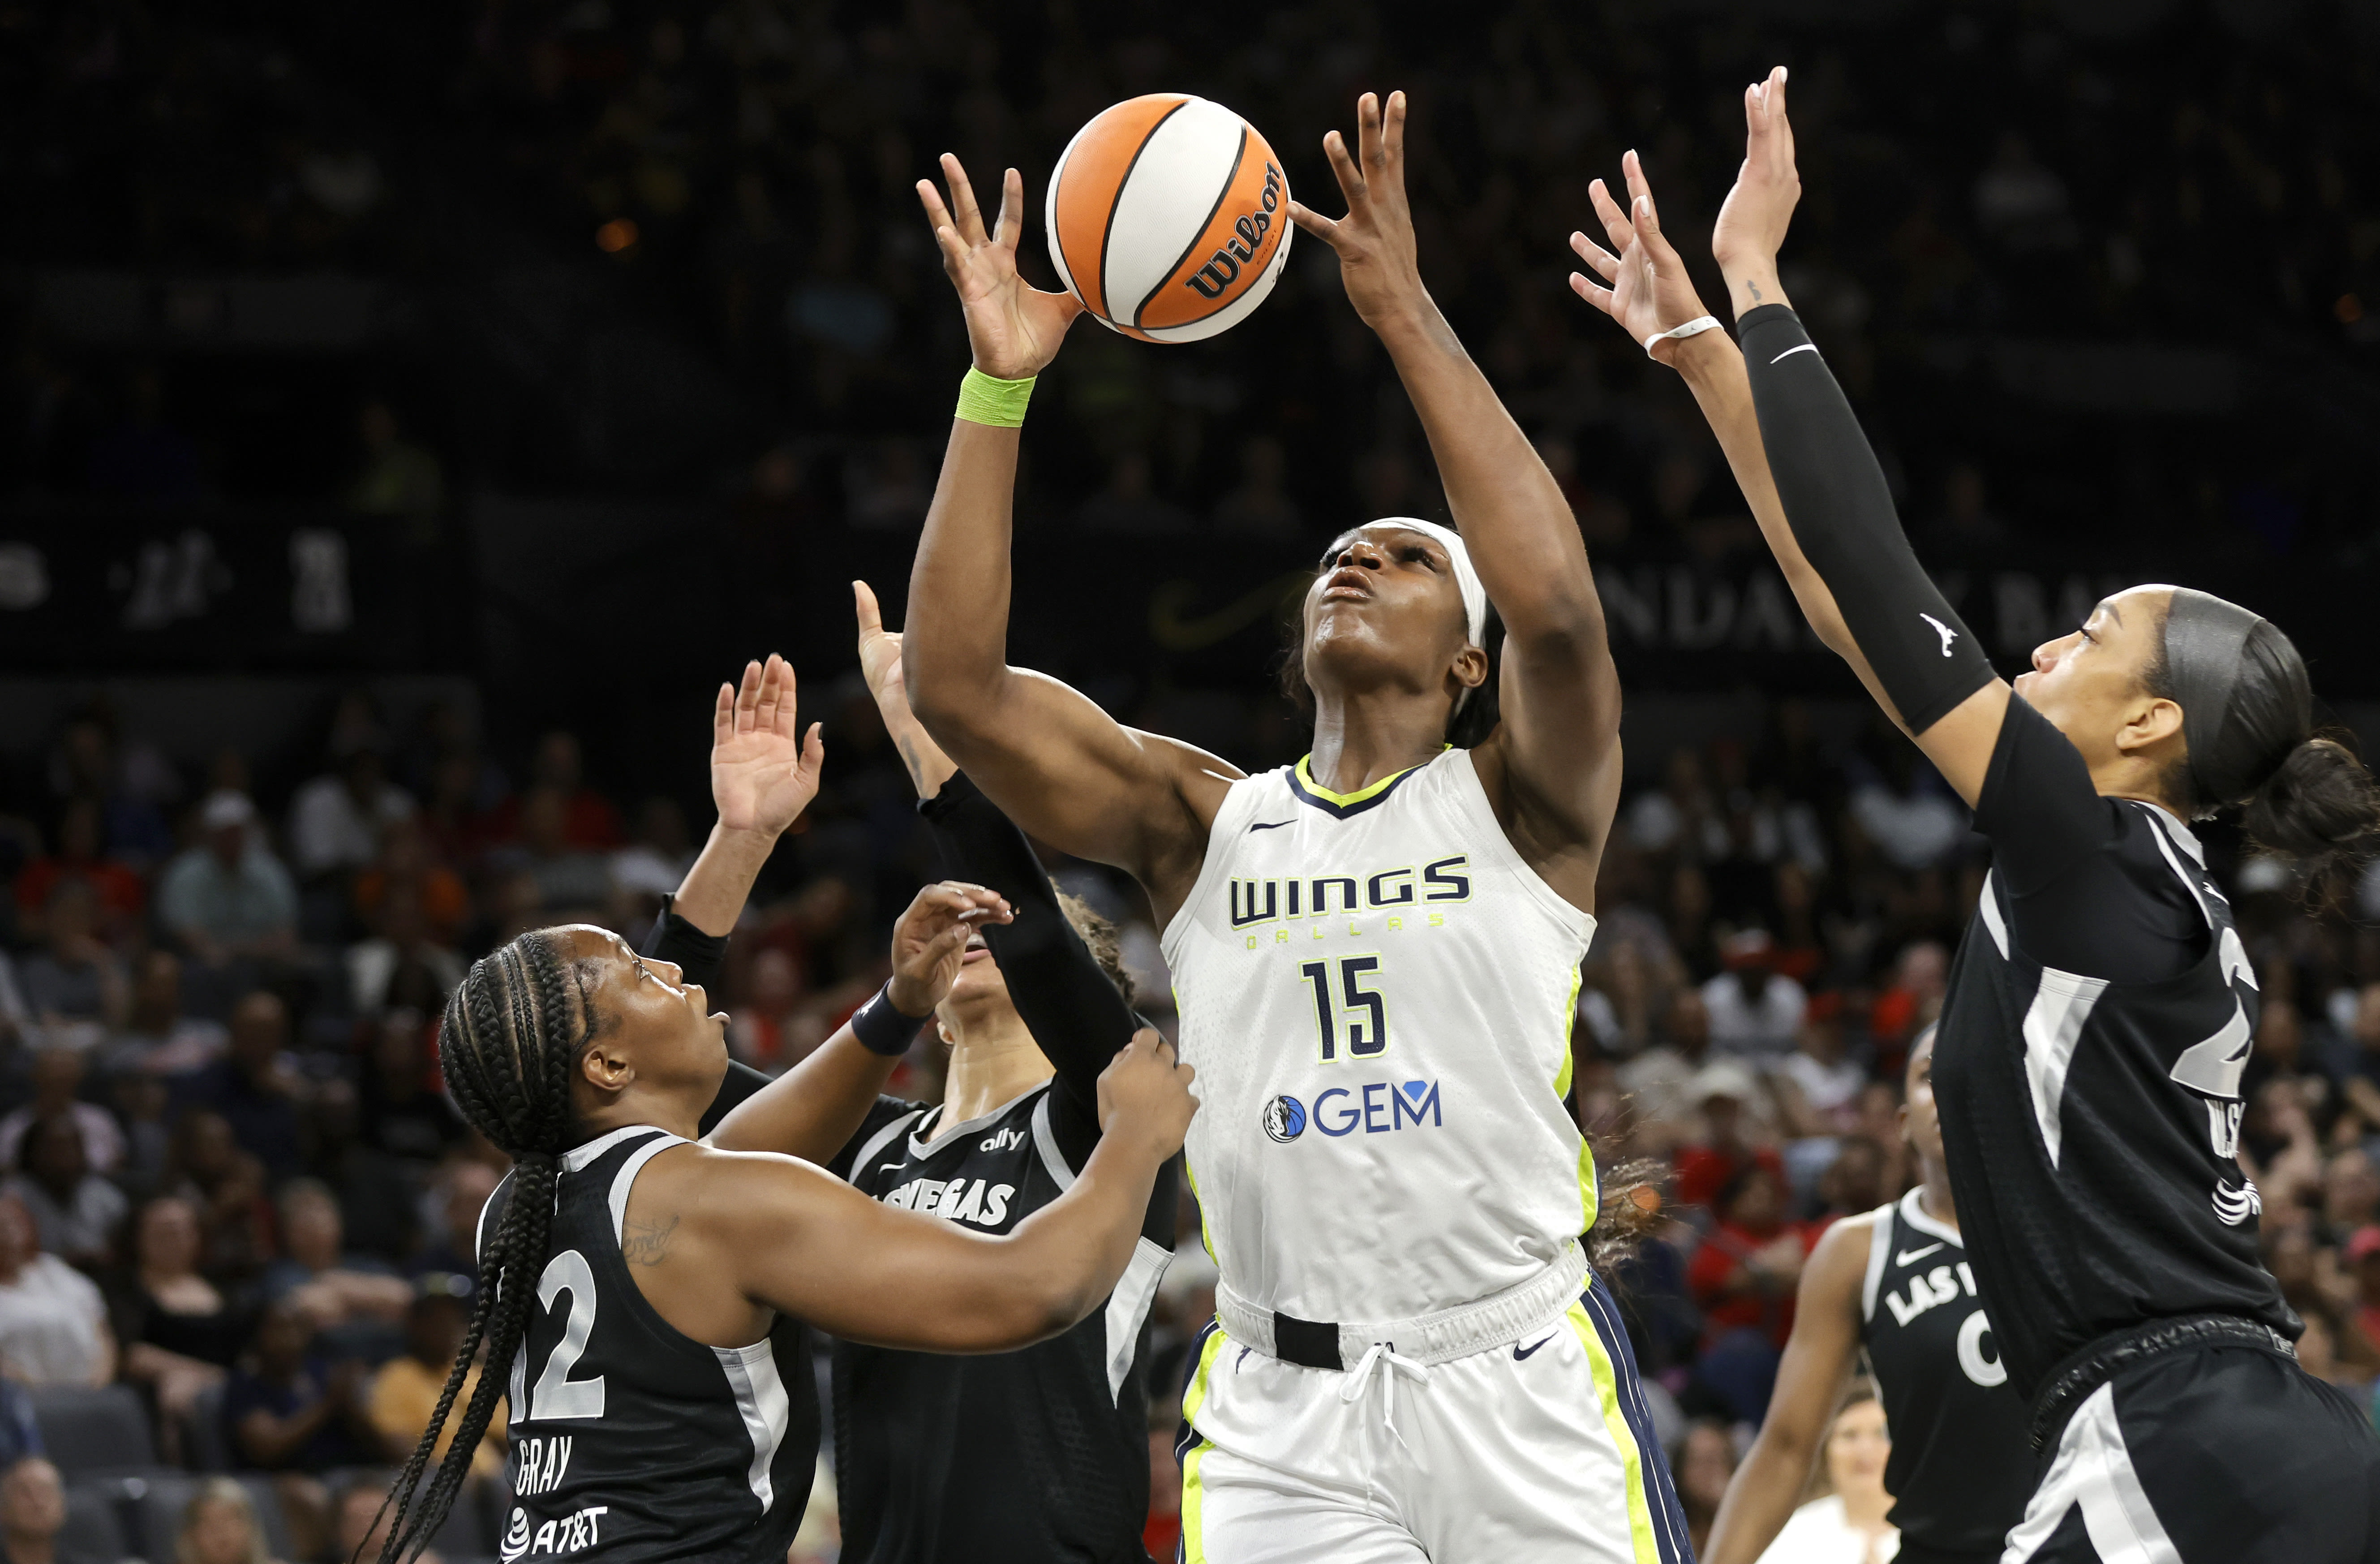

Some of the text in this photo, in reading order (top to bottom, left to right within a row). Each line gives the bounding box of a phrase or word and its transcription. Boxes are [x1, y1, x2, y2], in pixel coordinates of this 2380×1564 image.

[1183, 160, 1282, 299] Wilson
[1229, 853, 1473, 930] WINGS
[1246, 913, 1443, 950] DALLAS
[1298, 952, 1390, 1064] 15
[1313, 1079, 1442, 1137] GEM
[979, 1127, 1026, 1152] ally
[900, 1178, 1016, 1226] VEGAS
[1885, 1265, 1959, 1327] LAS
[516, 1436, 572, 1497] GRAY
[532, 1506, 608, 1555] AT&T
